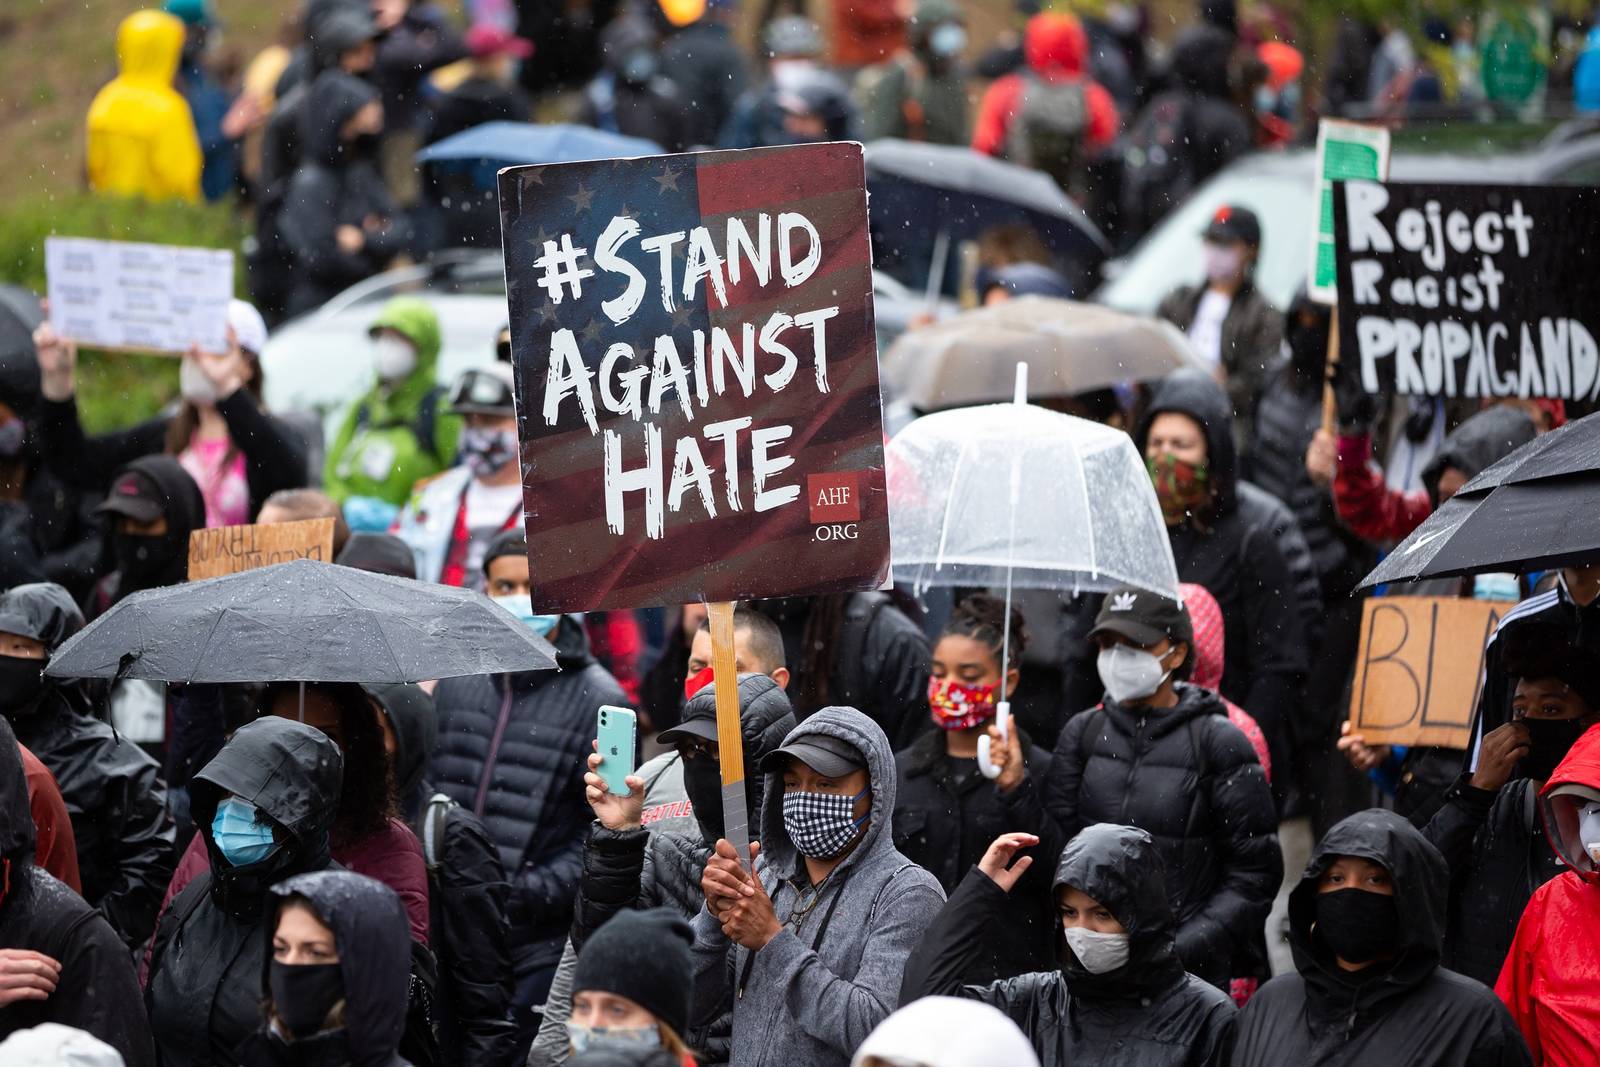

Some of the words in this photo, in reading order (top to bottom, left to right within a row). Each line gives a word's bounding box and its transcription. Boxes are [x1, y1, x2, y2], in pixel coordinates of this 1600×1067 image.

[533, 212, 822, 327] #STAND
[1344, 181, 1533, 271] Reject
[1351, 255, 1504, 312] Racist
[543, 306, 839, 436] AGAINST
[604, 416, 801, 540] HATE
[816, 486, 850, 506] AHF
[811, 523, 859, 542] .ORG
